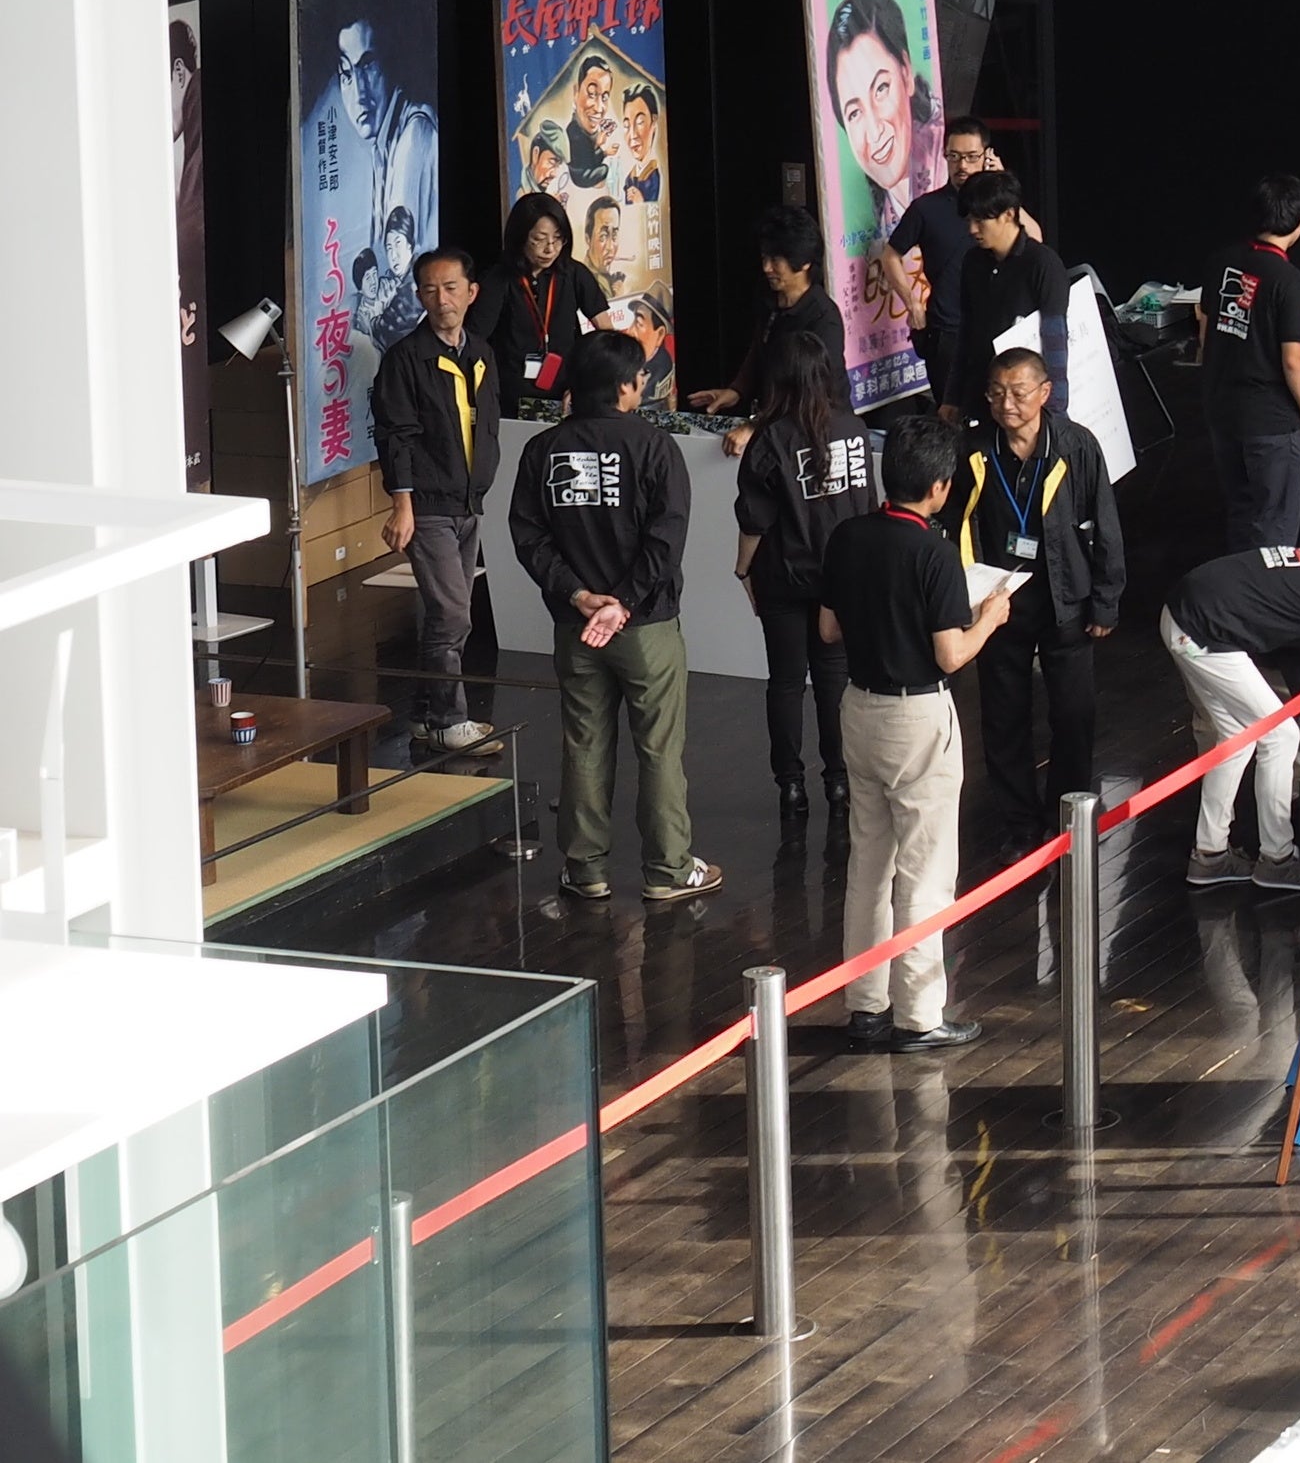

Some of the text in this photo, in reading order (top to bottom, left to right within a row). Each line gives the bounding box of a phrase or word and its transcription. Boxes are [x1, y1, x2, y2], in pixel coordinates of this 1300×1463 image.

[315, 218, 352, 466] その夜の妻
[600, 452, 621, 508] STAFF
[847, 436, 867, 488] STAFF
